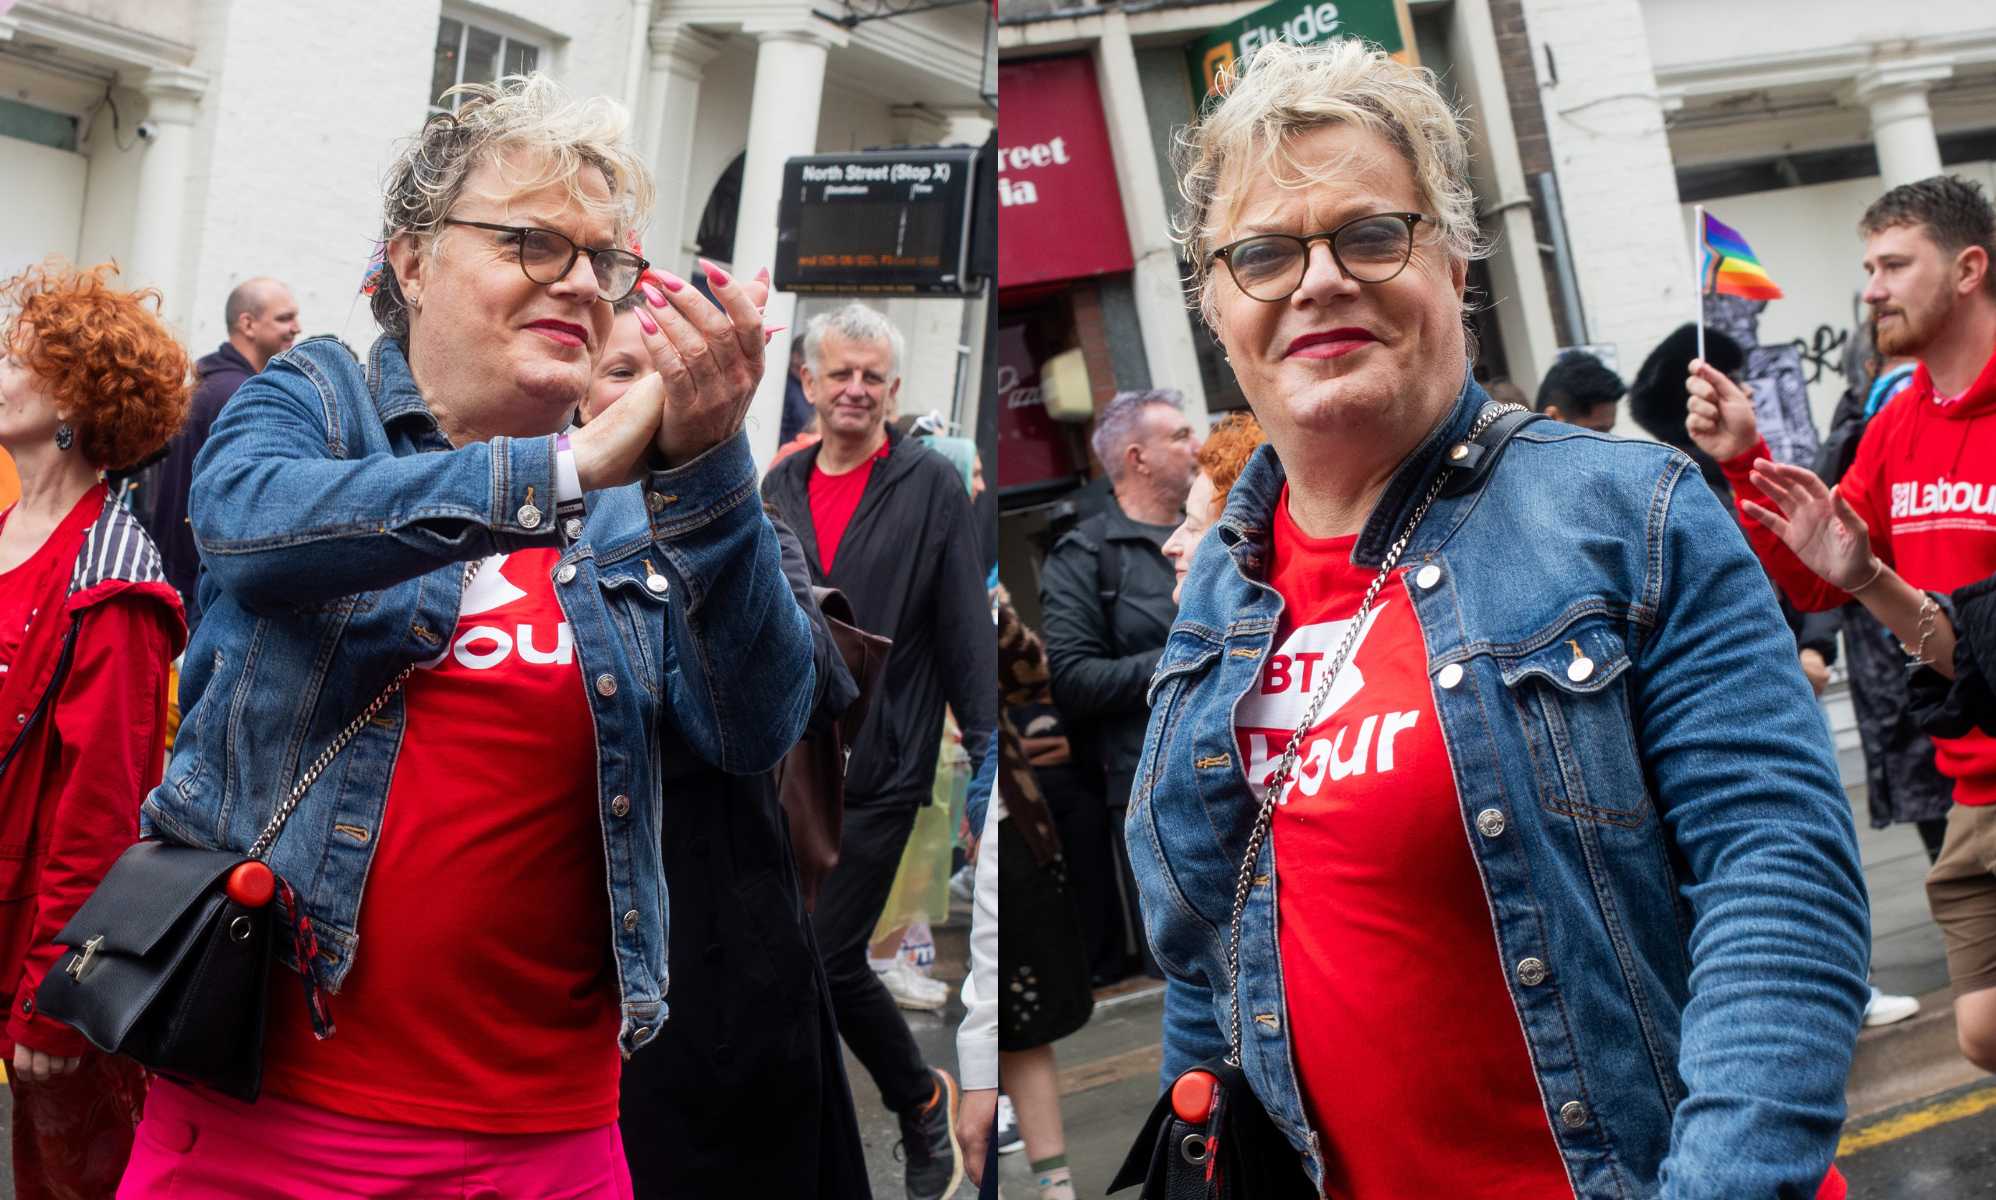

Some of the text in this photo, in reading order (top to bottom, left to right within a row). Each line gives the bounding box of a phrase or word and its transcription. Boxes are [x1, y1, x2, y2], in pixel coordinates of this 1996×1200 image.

[802, 162, 951, 184] North Street (Stop X)
